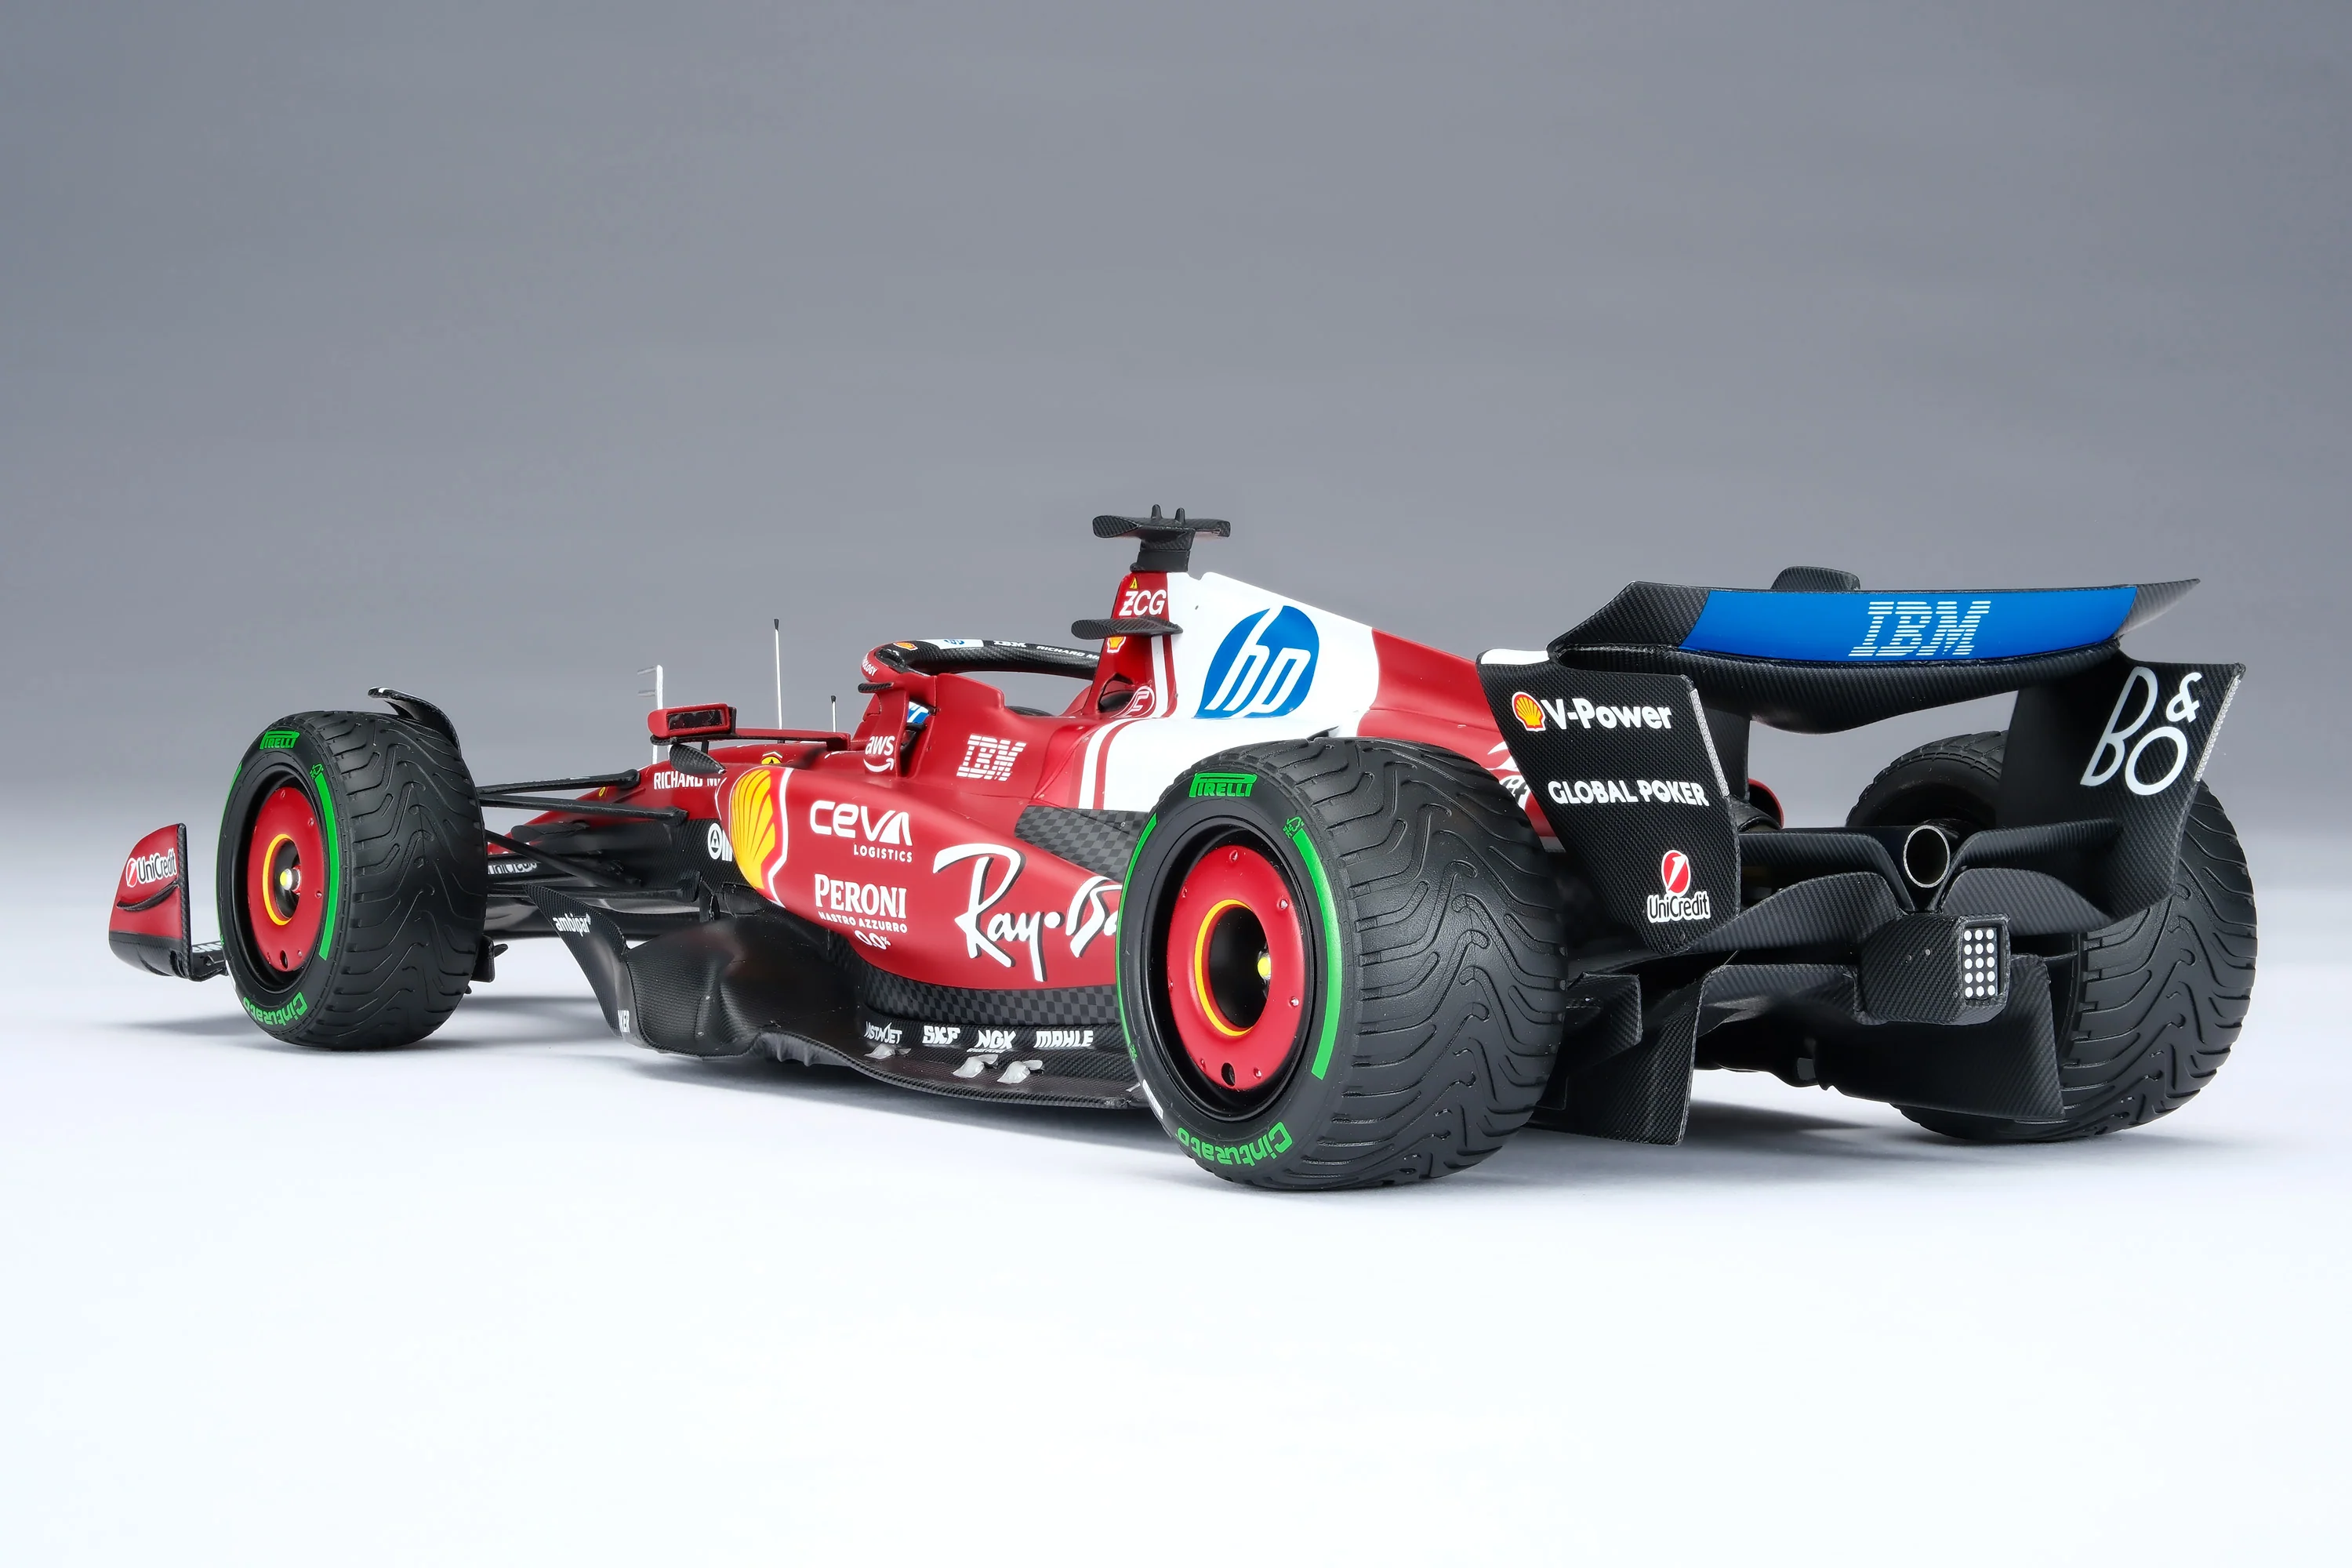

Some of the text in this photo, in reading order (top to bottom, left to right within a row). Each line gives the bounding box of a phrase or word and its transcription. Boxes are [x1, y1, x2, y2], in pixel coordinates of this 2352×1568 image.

[1119, 590, 1167, 616] ZCG
[1848, 601, 1991, 657] IBM
[1036, 645, 1086, 657] RICHARD
[1194, 605, 1319, 718] hp
[1541, 698, 1672, 730] V-Power
[260, 730, 300, 750] PIRELLI
[865, 735, 895, 756] aws
[956, 735, 1026, 781] IBM
[1189, 772, 1258, 797] PIRELLI
[1548, 779, 1639, 804] GLOBAL
[1637, 779, 1709, 806] POKER
[136, 848, 176, 883] UniCredit
[853, 844, 913, 862] LOGISTICS
[815, 873, 907, 919] PERONI
[1648, 892, 1710, 921] UniCredit
[553, 913, 590, 936] ambipar
[818, 911, 908, 933] NASTRO AZZURRO
[922, 1025, 960, 1044] SKF
[974, 1029, 1016, 1049] NGK
[1033, 1030, 1093, 1047] MAHLE
